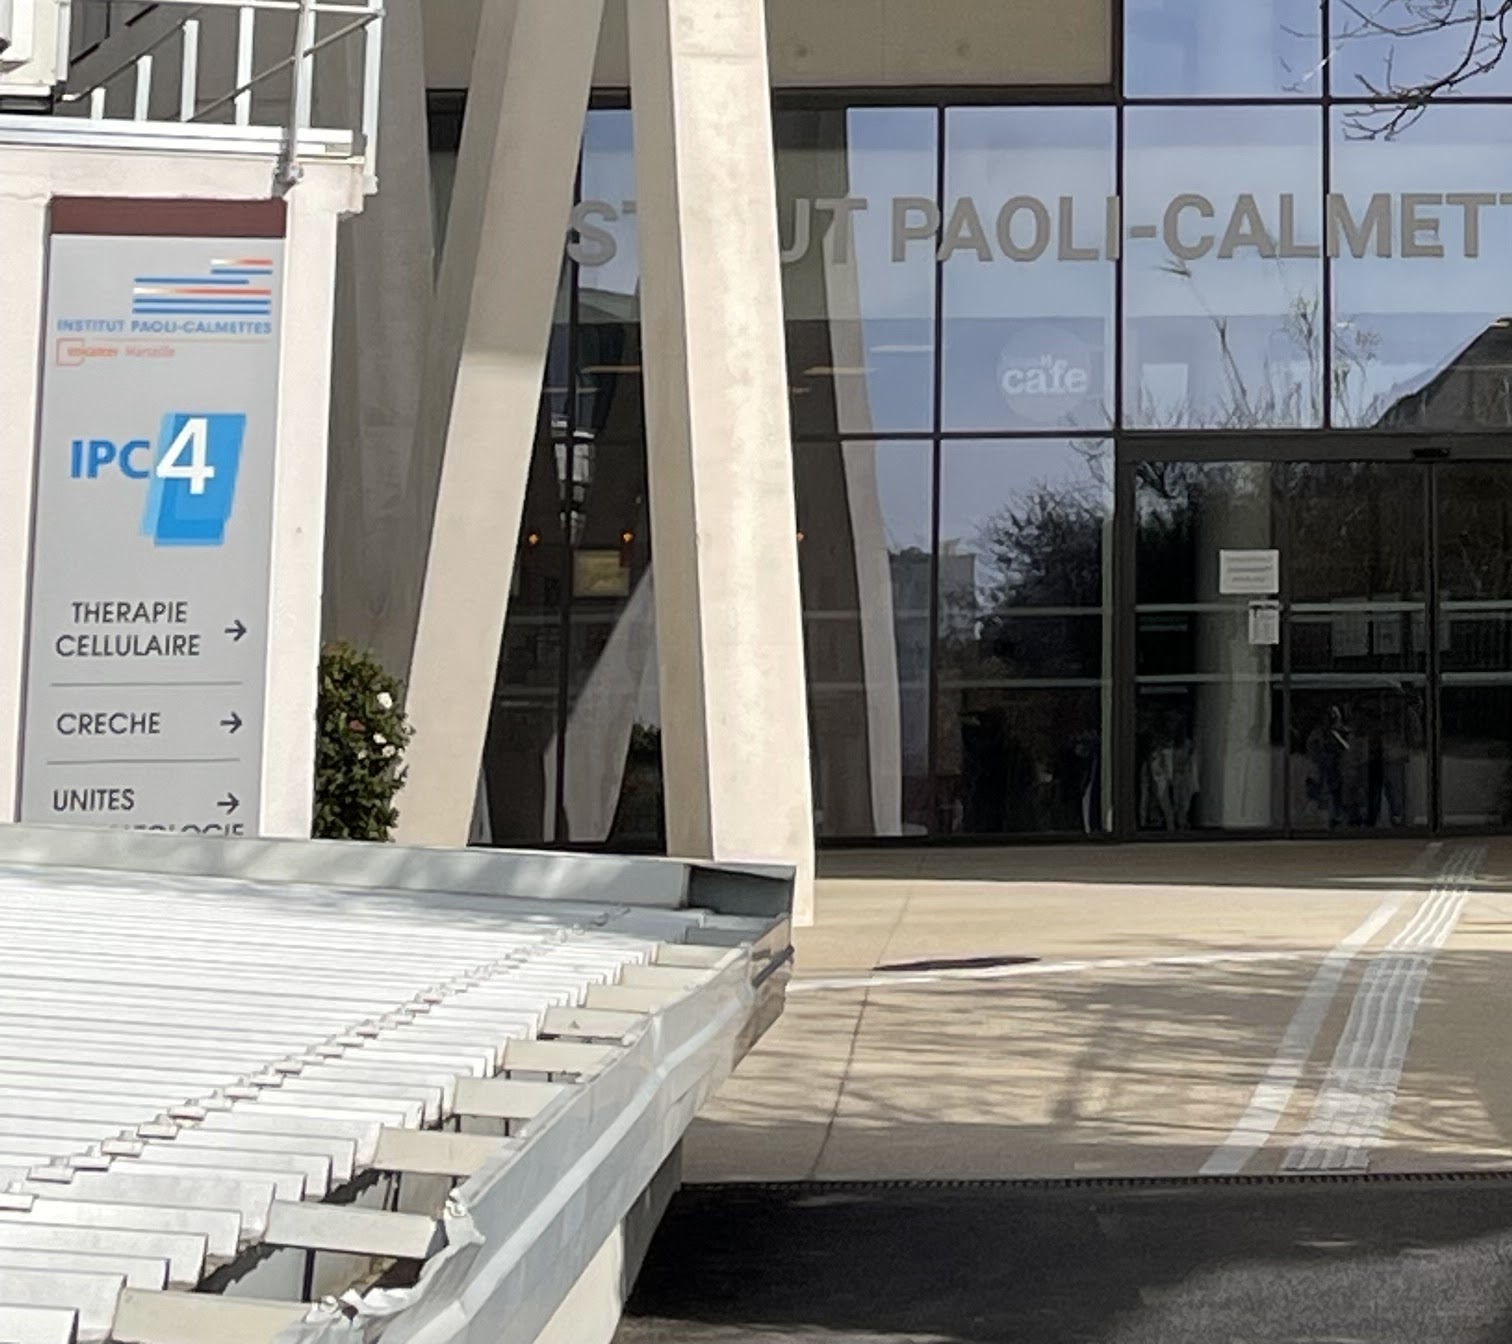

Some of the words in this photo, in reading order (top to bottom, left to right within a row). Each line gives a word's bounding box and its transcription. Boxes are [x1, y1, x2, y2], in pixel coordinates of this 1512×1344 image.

[56, 319, 125, 333] INSTITUT
[131, 320, 272, 334] PAOLI-CALMETTES
[71, 601, 189, 624] THERAPIE
[55, 634, 201, 657] CELLULAIRE
[56, 713, 161, 735] CRECHE
[53, 788, 135, 811] UNITES
